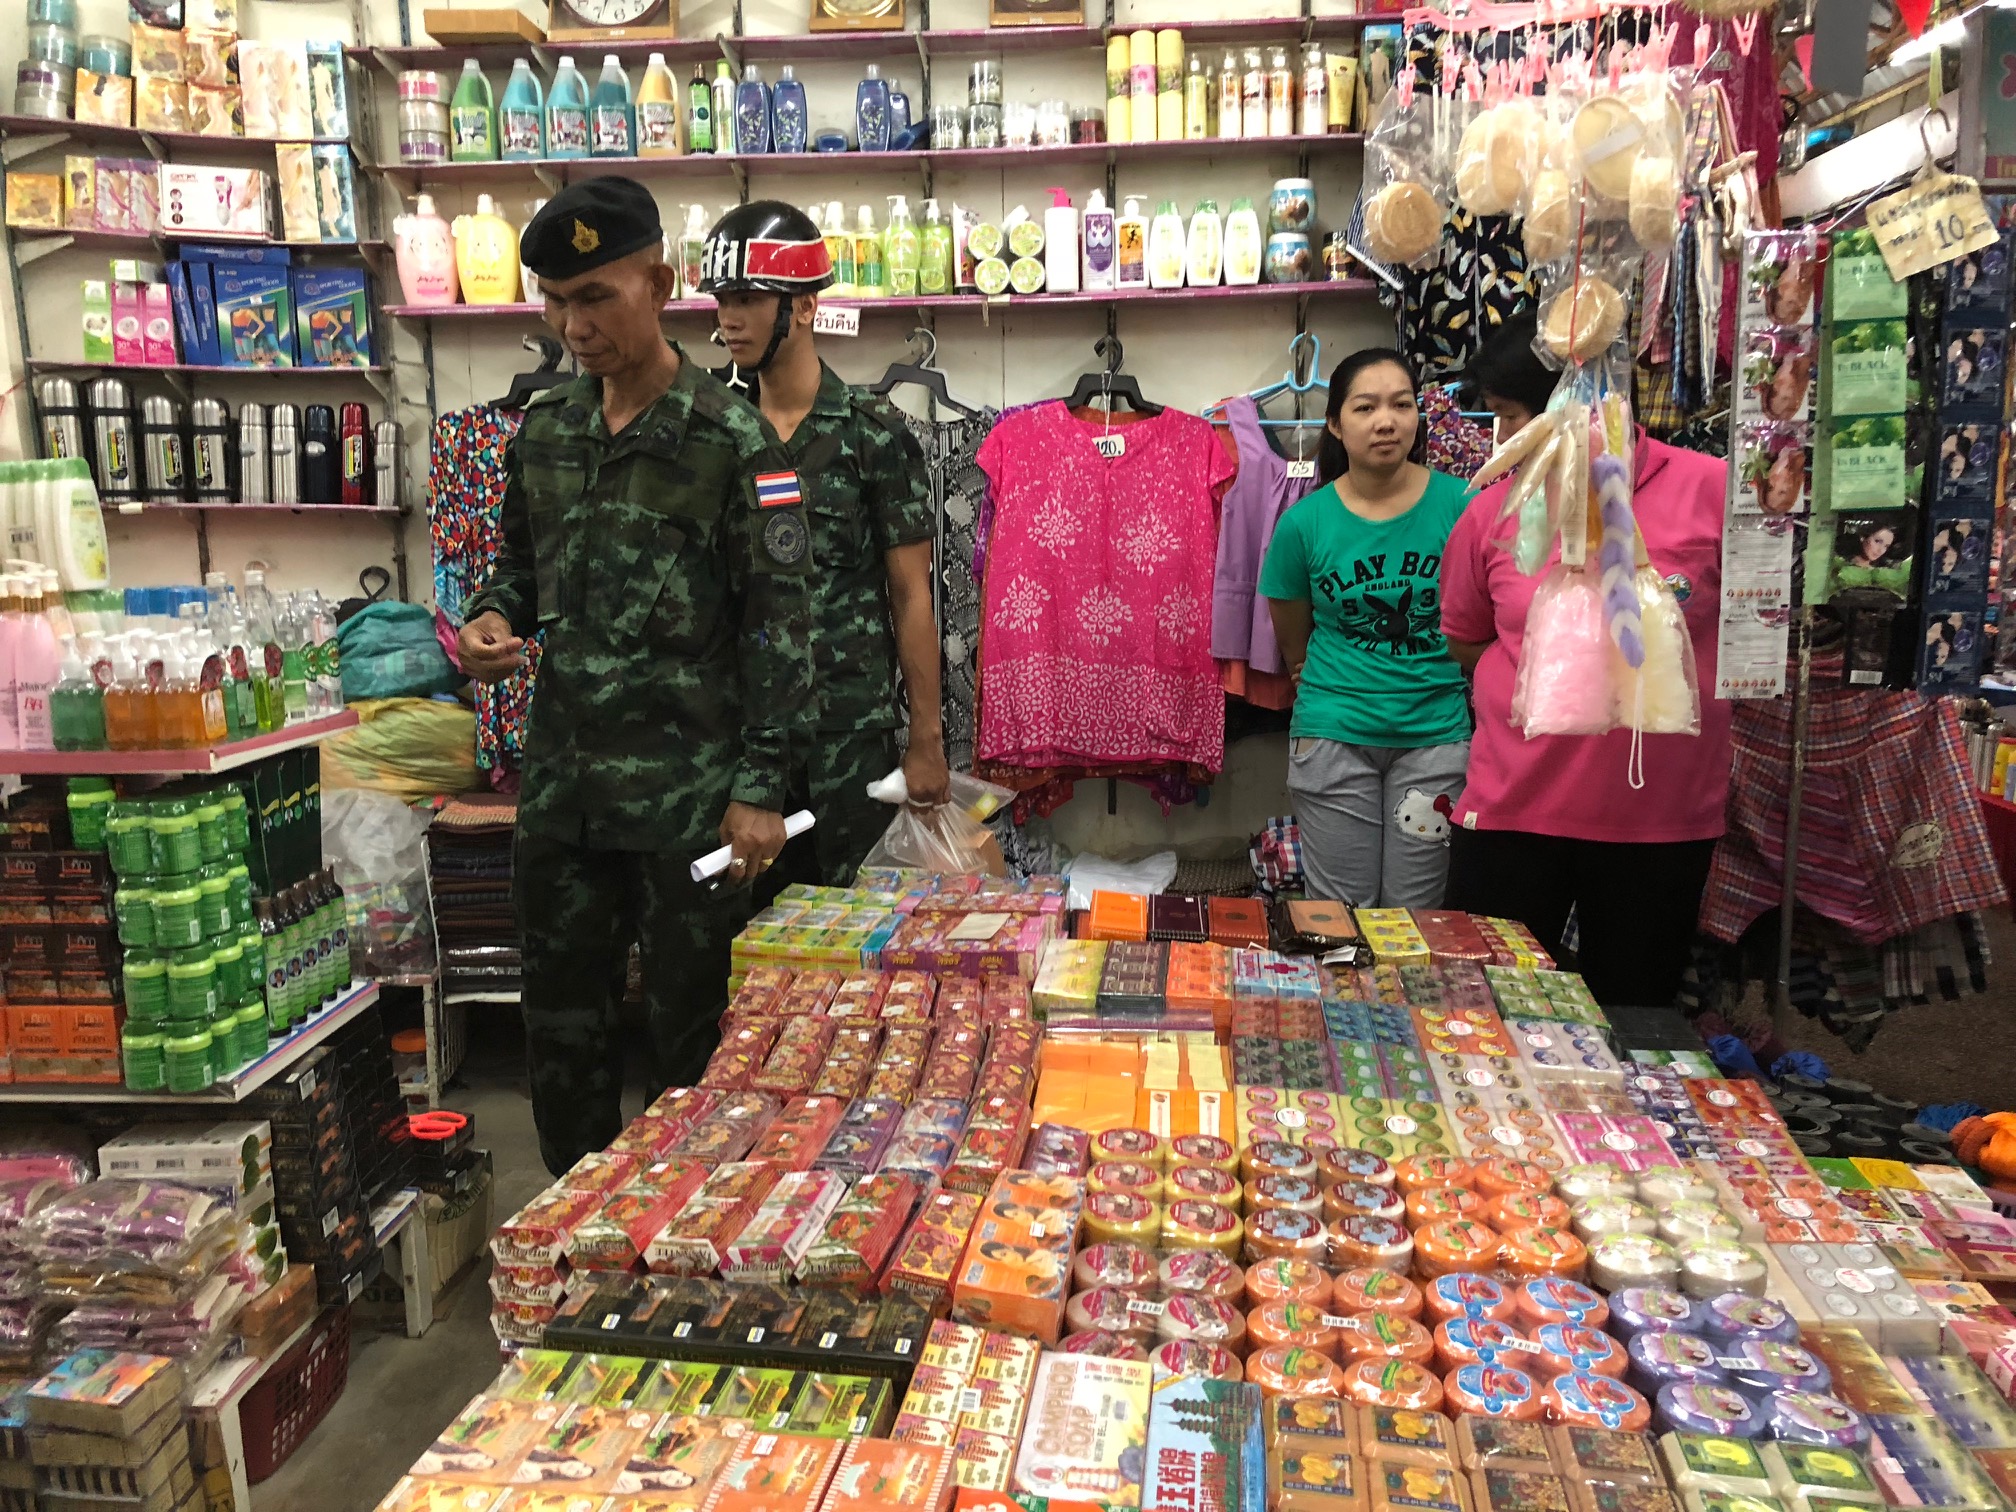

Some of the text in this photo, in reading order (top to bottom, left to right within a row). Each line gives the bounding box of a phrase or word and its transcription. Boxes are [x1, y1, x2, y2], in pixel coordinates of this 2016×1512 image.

[1935, 213, 1964, 249] 10
[1318, 551, 1441, 603] PLAY BO
[1365, 578, 1411, 592] ENGLAND
[1420, 588, 1436, 607] 3
[1033, 1360, 1080, 1456] CAMPHOR
[1063, 1404, 1098, 1460] SOAP
